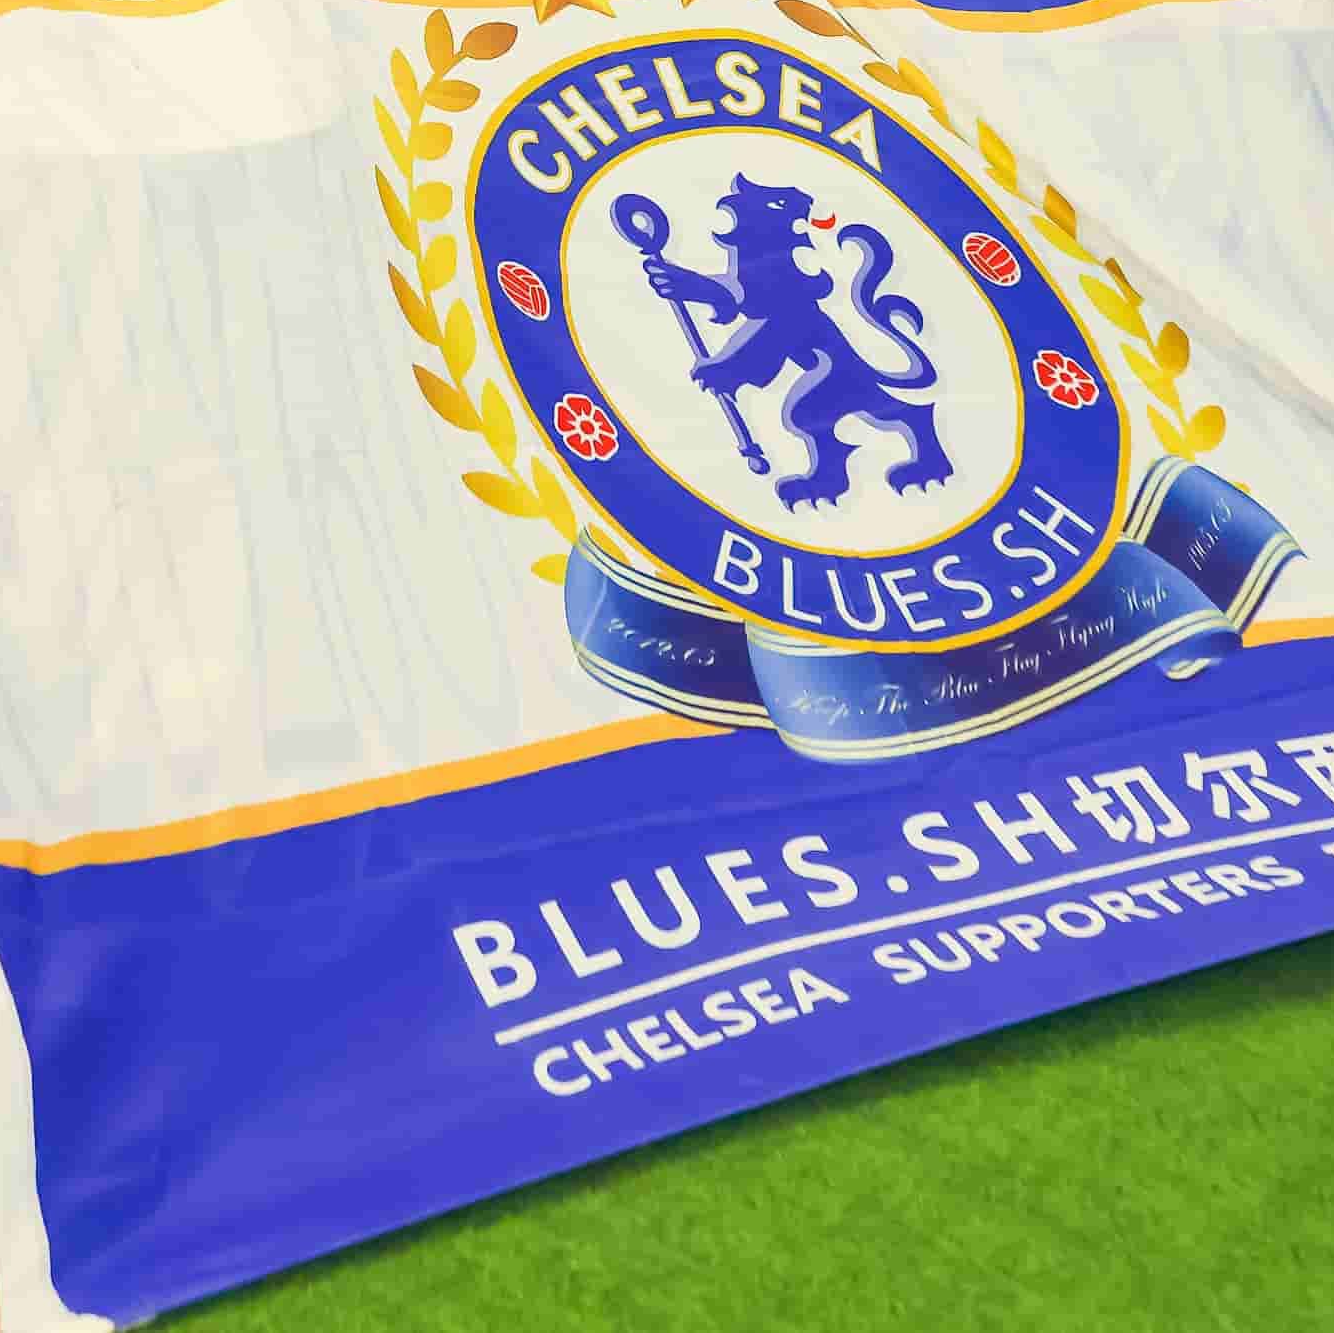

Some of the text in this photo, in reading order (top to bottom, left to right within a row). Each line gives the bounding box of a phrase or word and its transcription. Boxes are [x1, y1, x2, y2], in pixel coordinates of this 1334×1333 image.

[507, 50, 883, 194] CHELSEA
[713, 485, 1096, 634] BLUES.SH
[533, 967, 851, 1097] CHELSEA
[873, 854, 1305, 986] SUPPORTERS
